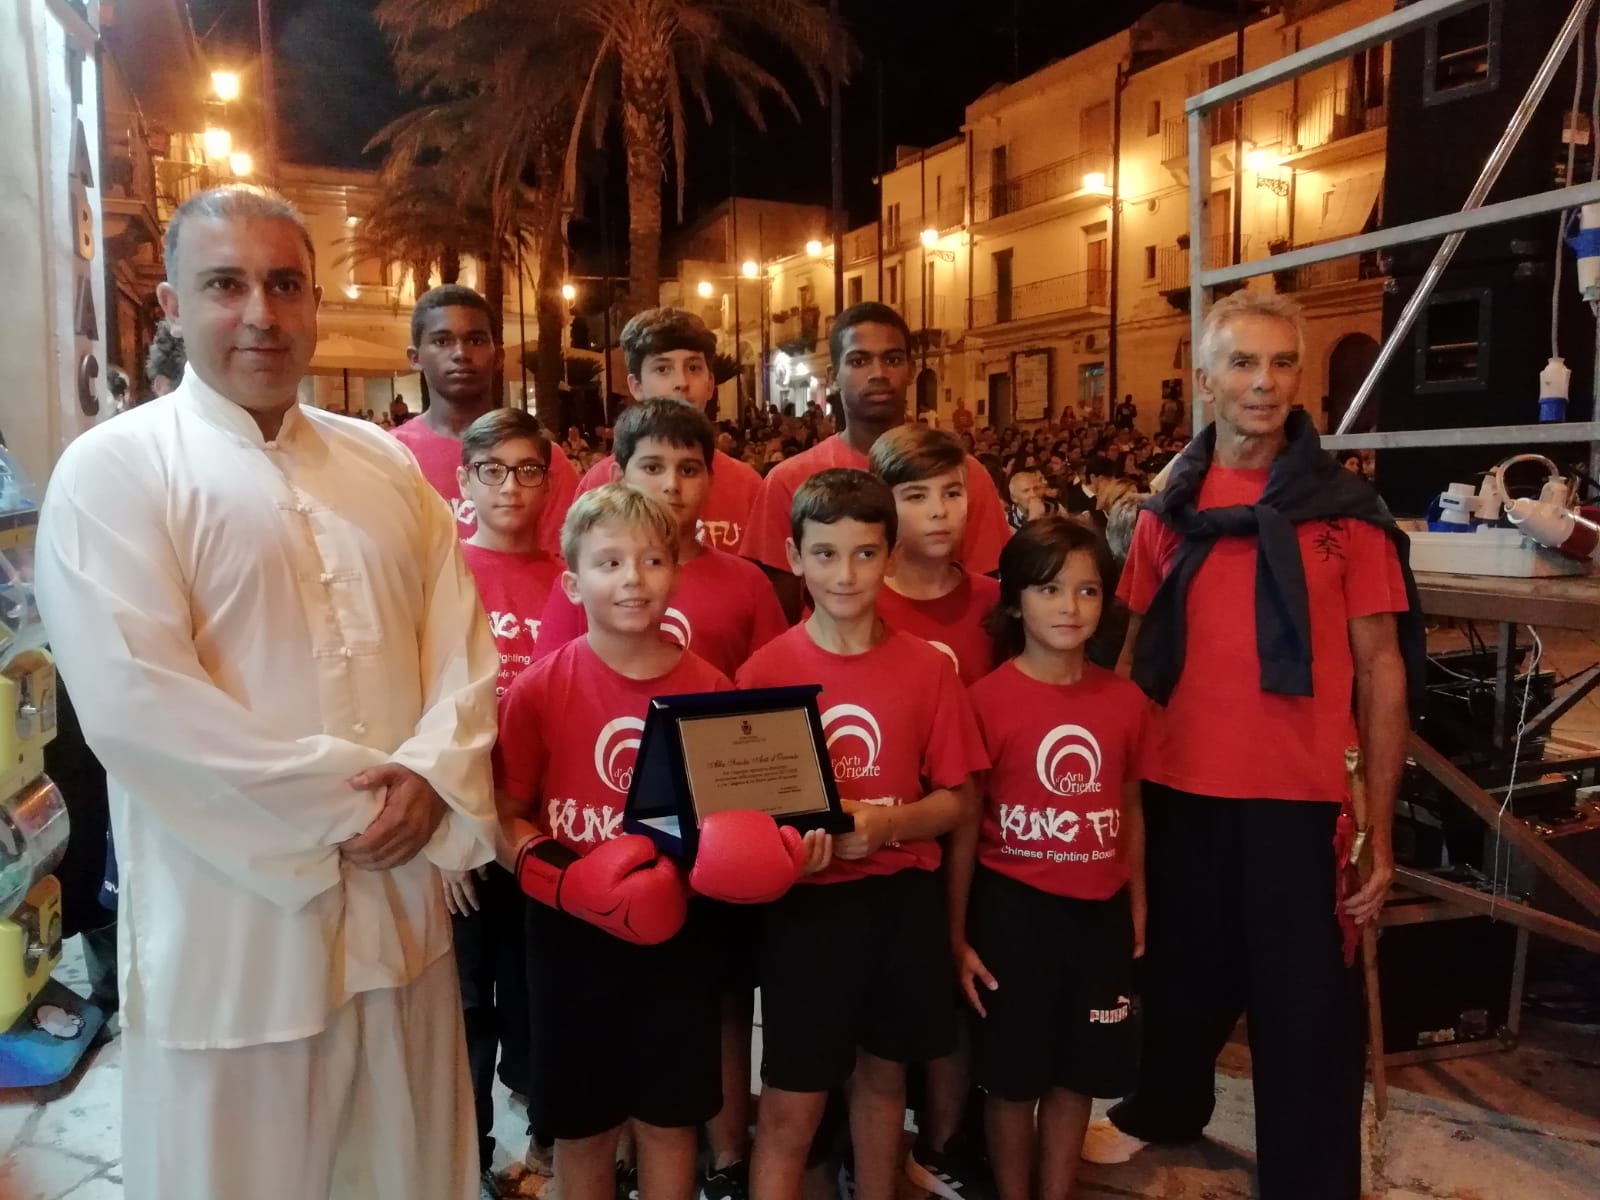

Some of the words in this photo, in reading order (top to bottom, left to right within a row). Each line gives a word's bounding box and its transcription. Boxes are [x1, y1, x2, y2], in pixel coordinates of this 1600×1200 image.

[841, 755, 861, 766] Arti
[1000, 804, 1081, 843] KUNG
[1085, 808, 1120, 849] FU
[1001, 845, 1043, 859] Chinese
[1046, 850, 1089, 863] Fighting
